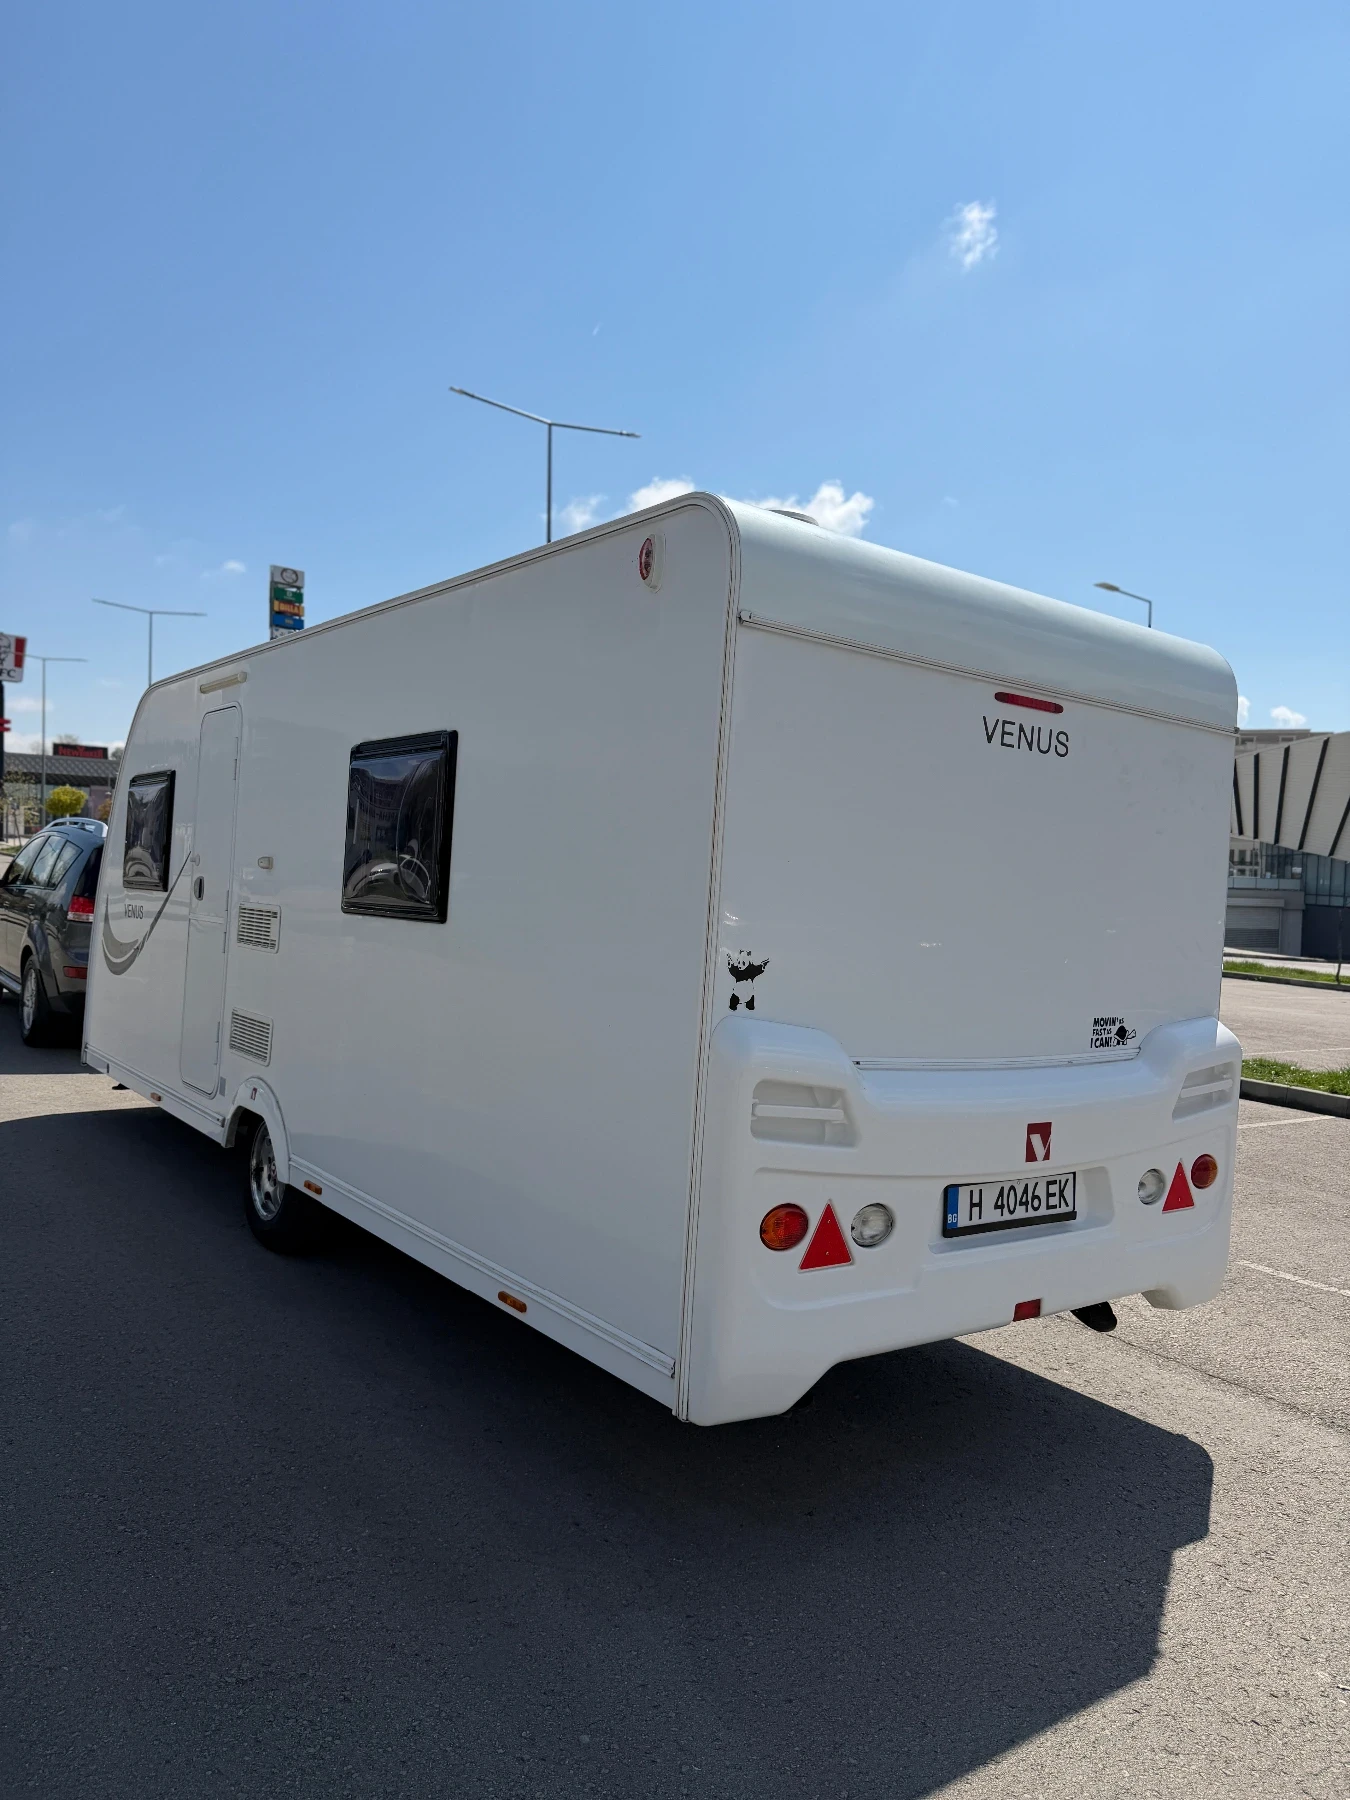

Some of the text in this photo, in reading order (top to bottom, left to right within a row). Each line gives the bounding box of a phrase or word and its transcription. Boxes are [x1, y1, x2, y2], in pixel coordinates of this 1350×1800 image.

[0, 668, 16, 678] FC
[983, 716, 1069, 757] VENUS
[124, 904, 144, 919] VENUS
[1093, 1017, 1118, 1027] MOVIN'
[1093, 1028, 1106, 1036] FAST
[1090, 1037, 1113, 1048] I CAN!
[969, 1178, 1070, 1221] H 4046 EK
[947, 1214, 958, 1223] BG
